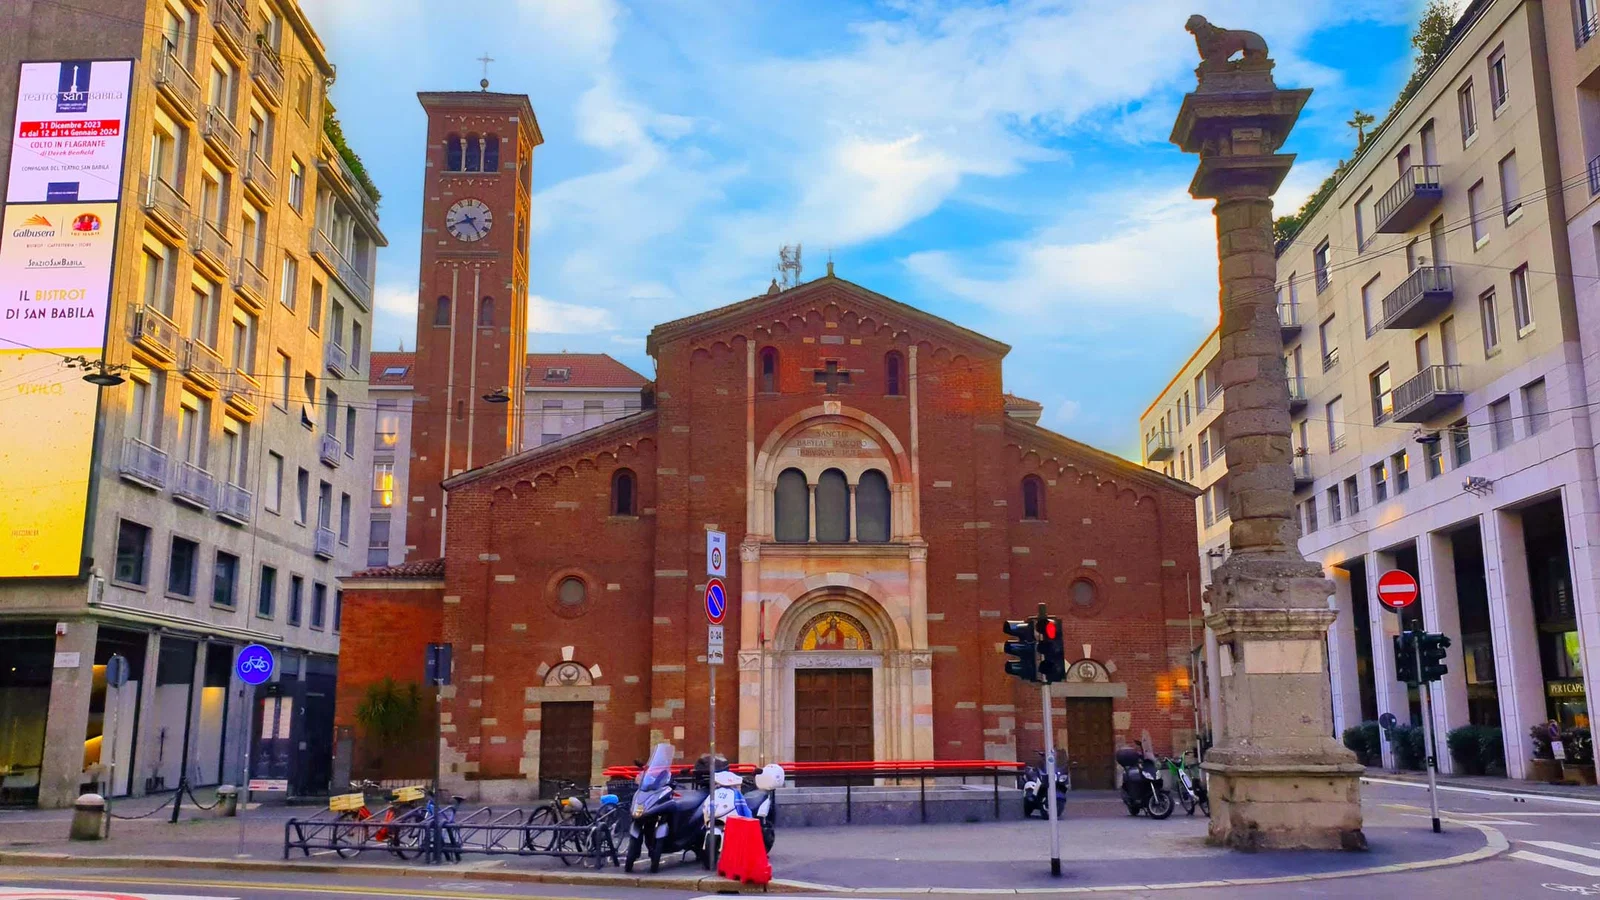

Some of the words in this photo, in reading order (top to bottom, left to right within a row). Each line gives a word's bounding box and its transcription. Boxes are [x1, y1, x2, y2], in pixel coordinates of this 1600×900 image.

[62, 92, 83, 101] san
[39, 121, 48, 129] 31
[50, 121, 81, 129] Dicembre
[28, 129, 39, 137] dal
[41, 129, 49, 137] 12
[51, 128, 58, 137] al
[60, 128, 68, 136] 14
[70, 128, 98, 136] Gennaio
[99, 128, 117, 136] 2024
[54, 140, 62, 148] IN
[64, 140, 106, 148] FLAGRANTE
[12, 228, 55, 238] Galbusera
[19, 290, 30, 301] IL
[35, 288, 87, 301] BISTROT
[6, 308, 19, 320] DI
[24, 307, 46, 319] SAN
[51, 307, 95, 319] BABILA
[1550, 684, 1563, 693] PER
